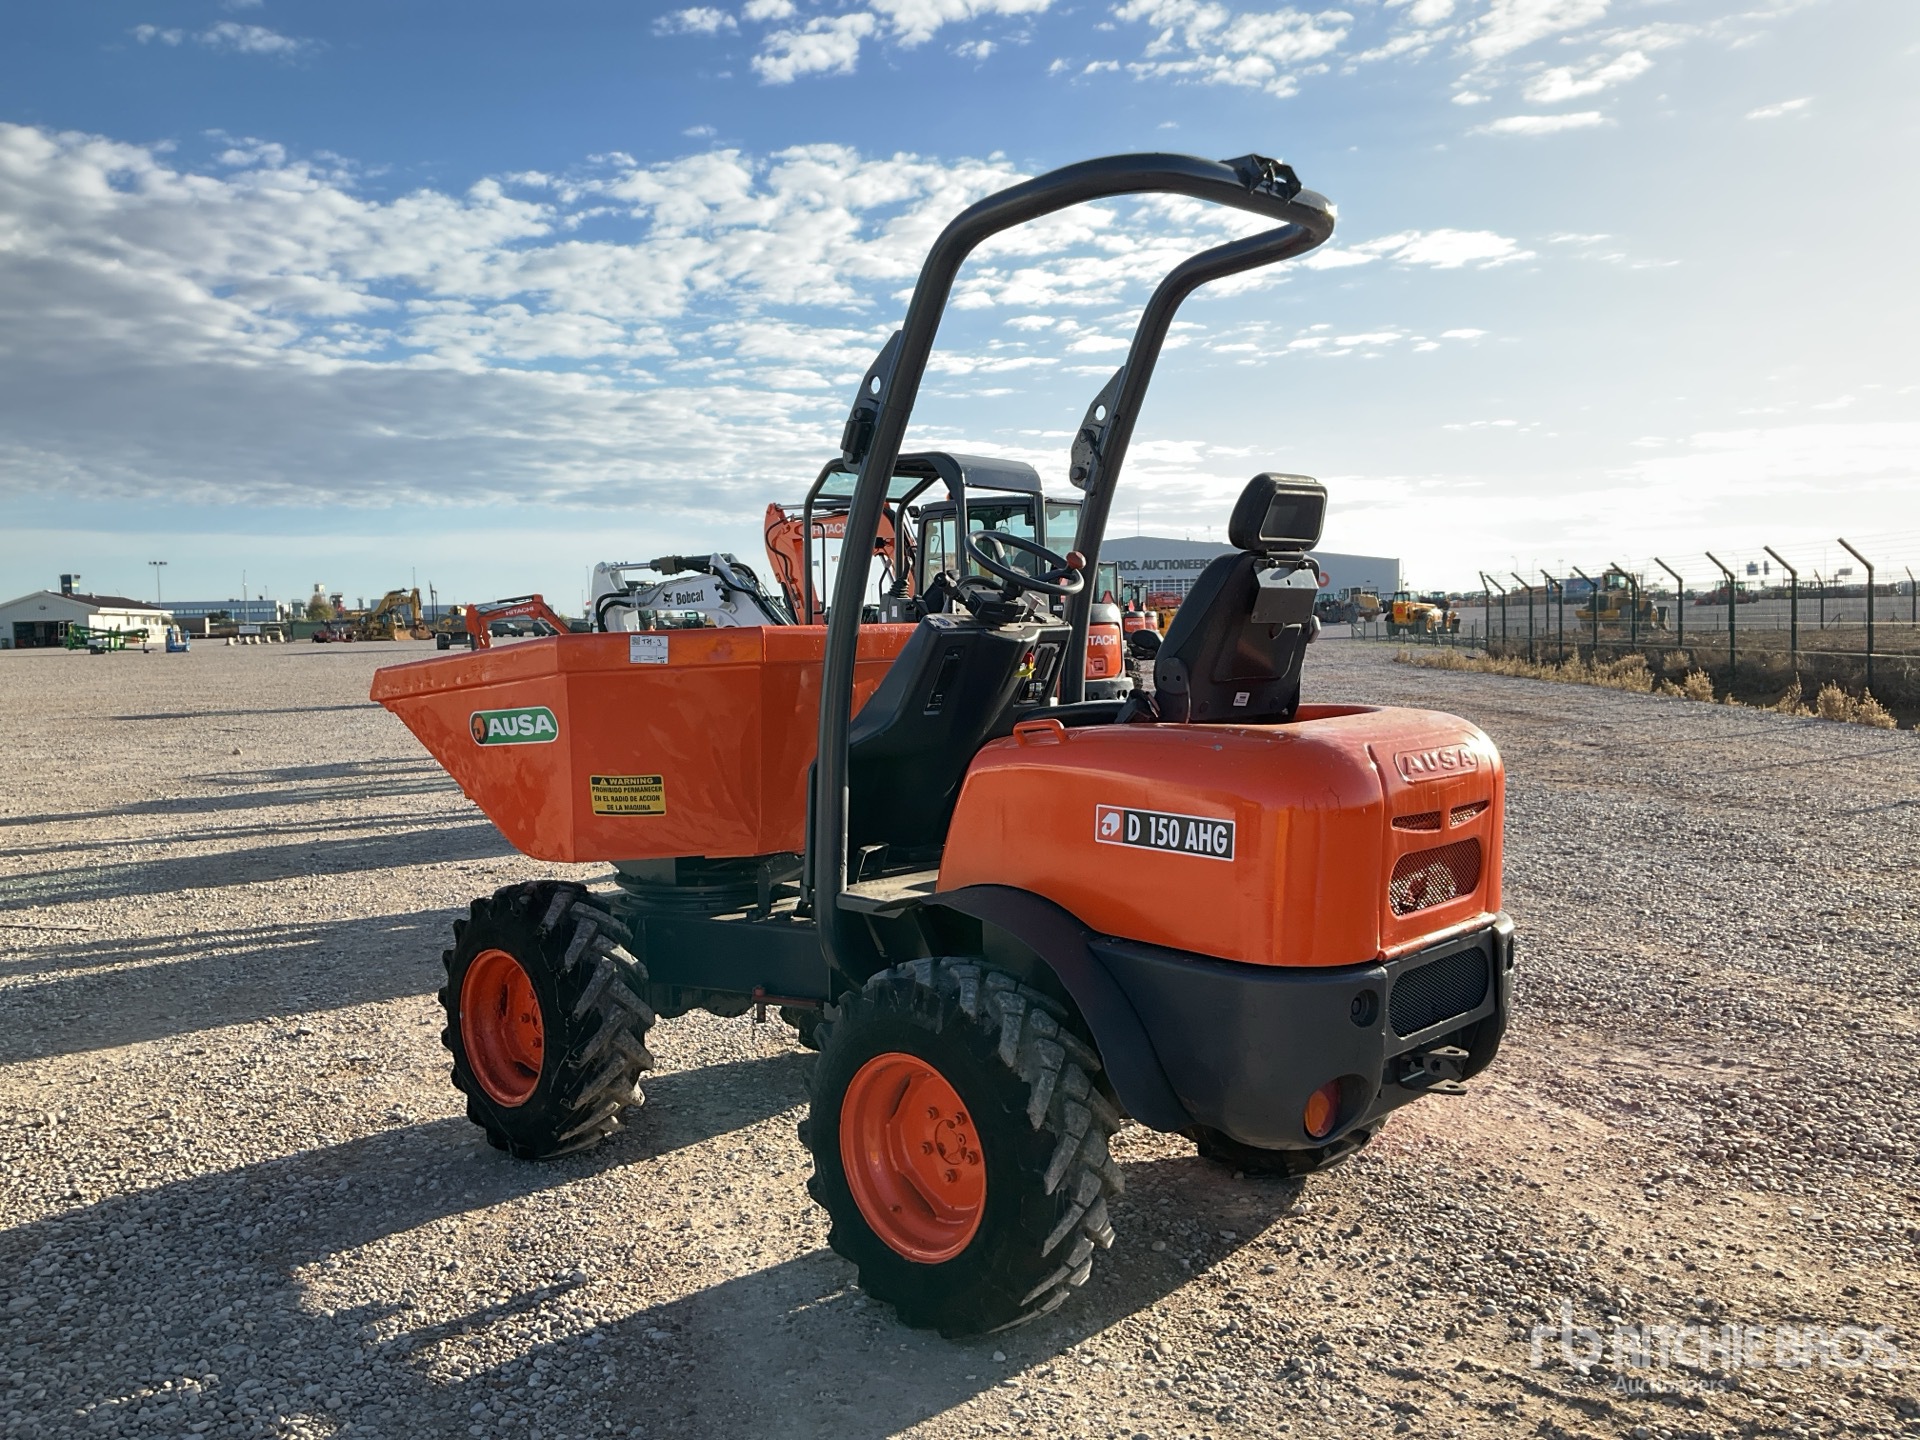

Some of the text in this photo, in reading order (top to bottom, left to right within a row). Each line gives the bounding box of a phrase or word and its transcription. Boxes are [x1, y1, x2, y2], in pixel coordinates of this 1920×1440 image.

[813, 523, 847, 535] HITACH
[1117, 560, 1140, 571] ROS.
[676, 589, 704, 605] Bobcat
[505, 606, 535, 616] HITACHI
[1088, 634, 1118, 646] TACHI
[488, 714, 555, 737] AUSA
[1402, 748, 1476, 775] AUSA
[608, 777, 654, 785] WARNING
[1127, 813, 1228, 854] D 150 AHG
